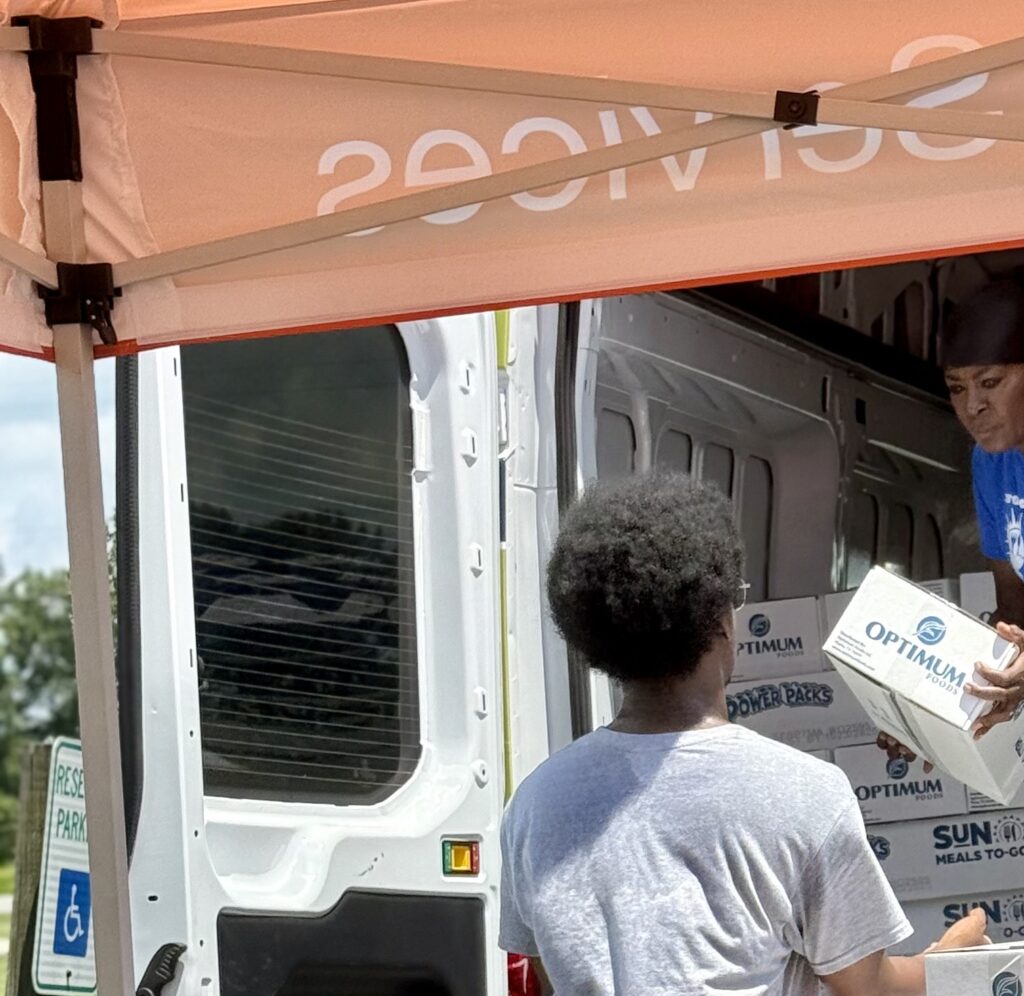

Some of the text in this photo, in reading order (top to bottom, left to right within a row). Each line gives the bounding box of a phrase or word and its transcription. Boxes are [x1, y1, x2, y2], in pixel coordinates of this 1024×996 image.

[737, 637, 803, 656] PTIMUM
[865, 621, 966, 688] OPTIMUM
[780, 682, 833, 708] PACKS
[926, 673, 957, 695] FOODS
[55, 764, 84, 797] RESE
[855, 779, 942, 801] OPTIMUM
[56, 808, 87, 841] PARK
[932, 821, 992, 849] SUN
[936, 852, 982, 865] MEALS
[943, 900, 1002, 928] SN
